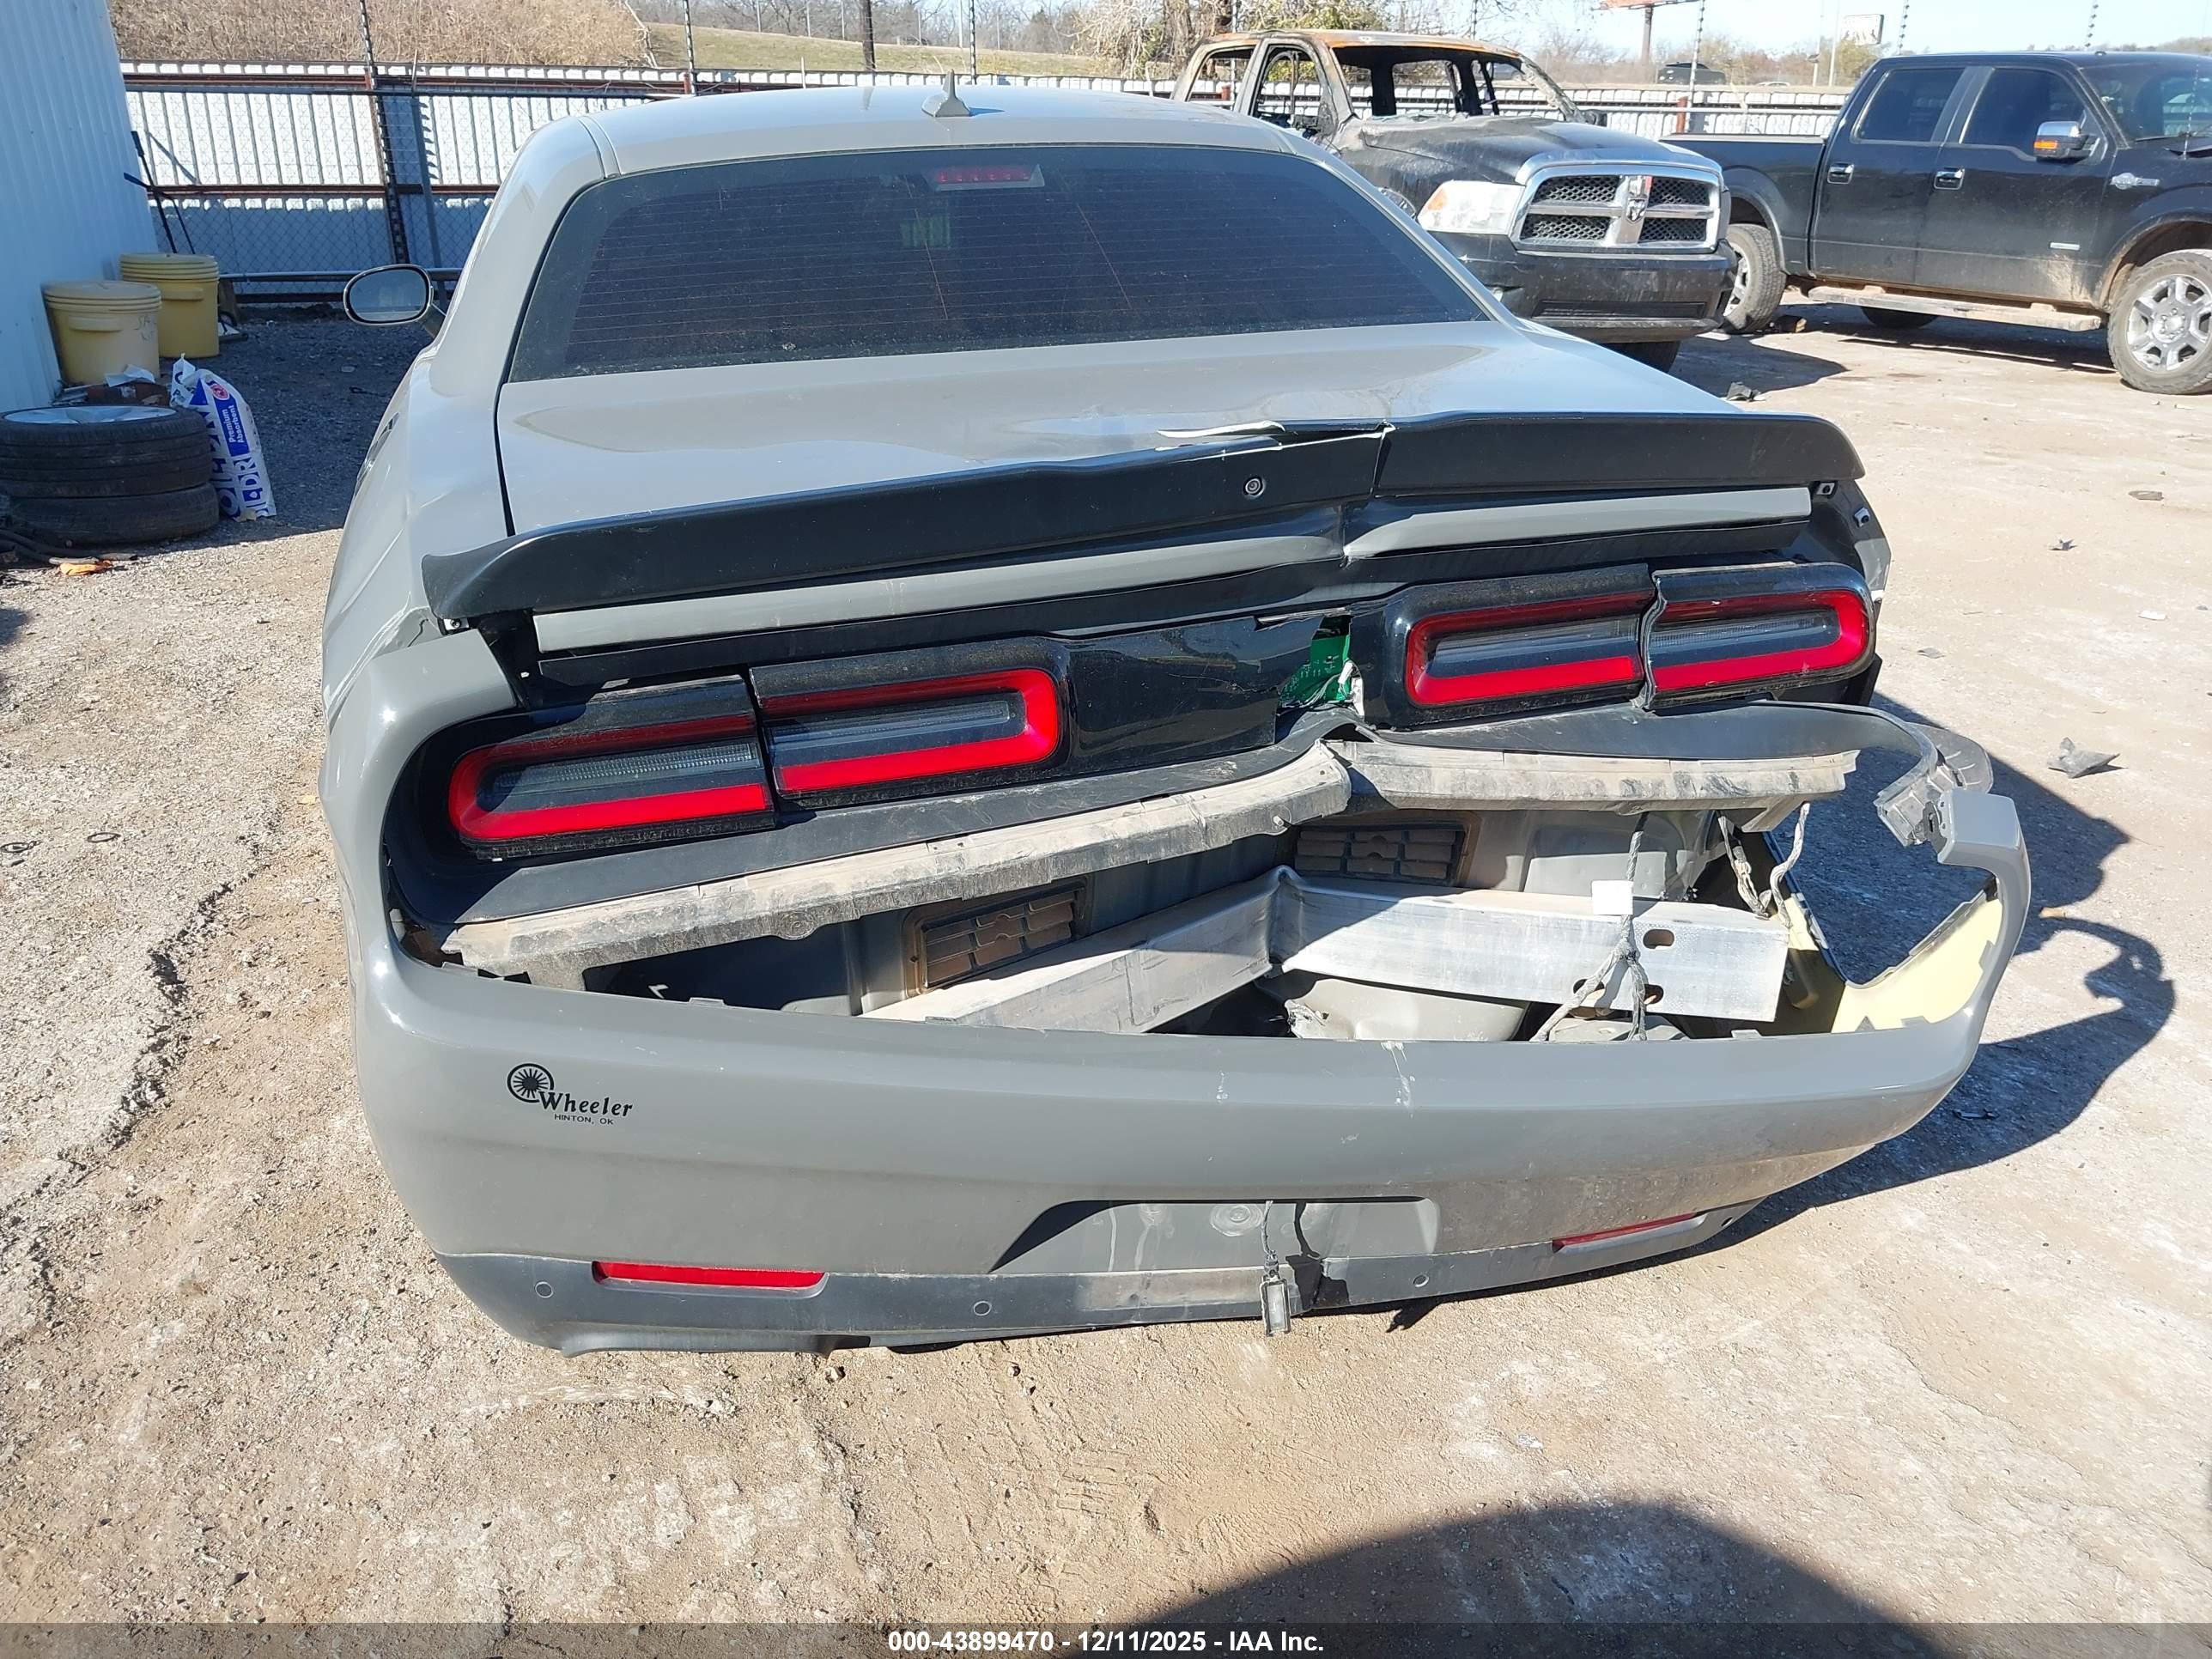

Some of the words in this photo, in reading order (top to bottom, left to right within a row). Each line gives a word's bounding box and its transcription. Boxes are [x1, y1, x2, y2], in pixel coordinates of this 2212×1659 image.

[222, 408, 236, 444] Premium
[228, 404, 246, 444] Absorbent
[538, 1091, 633, 1116] Wheeler
[554, 1115, 594, 1124] HINTON,
